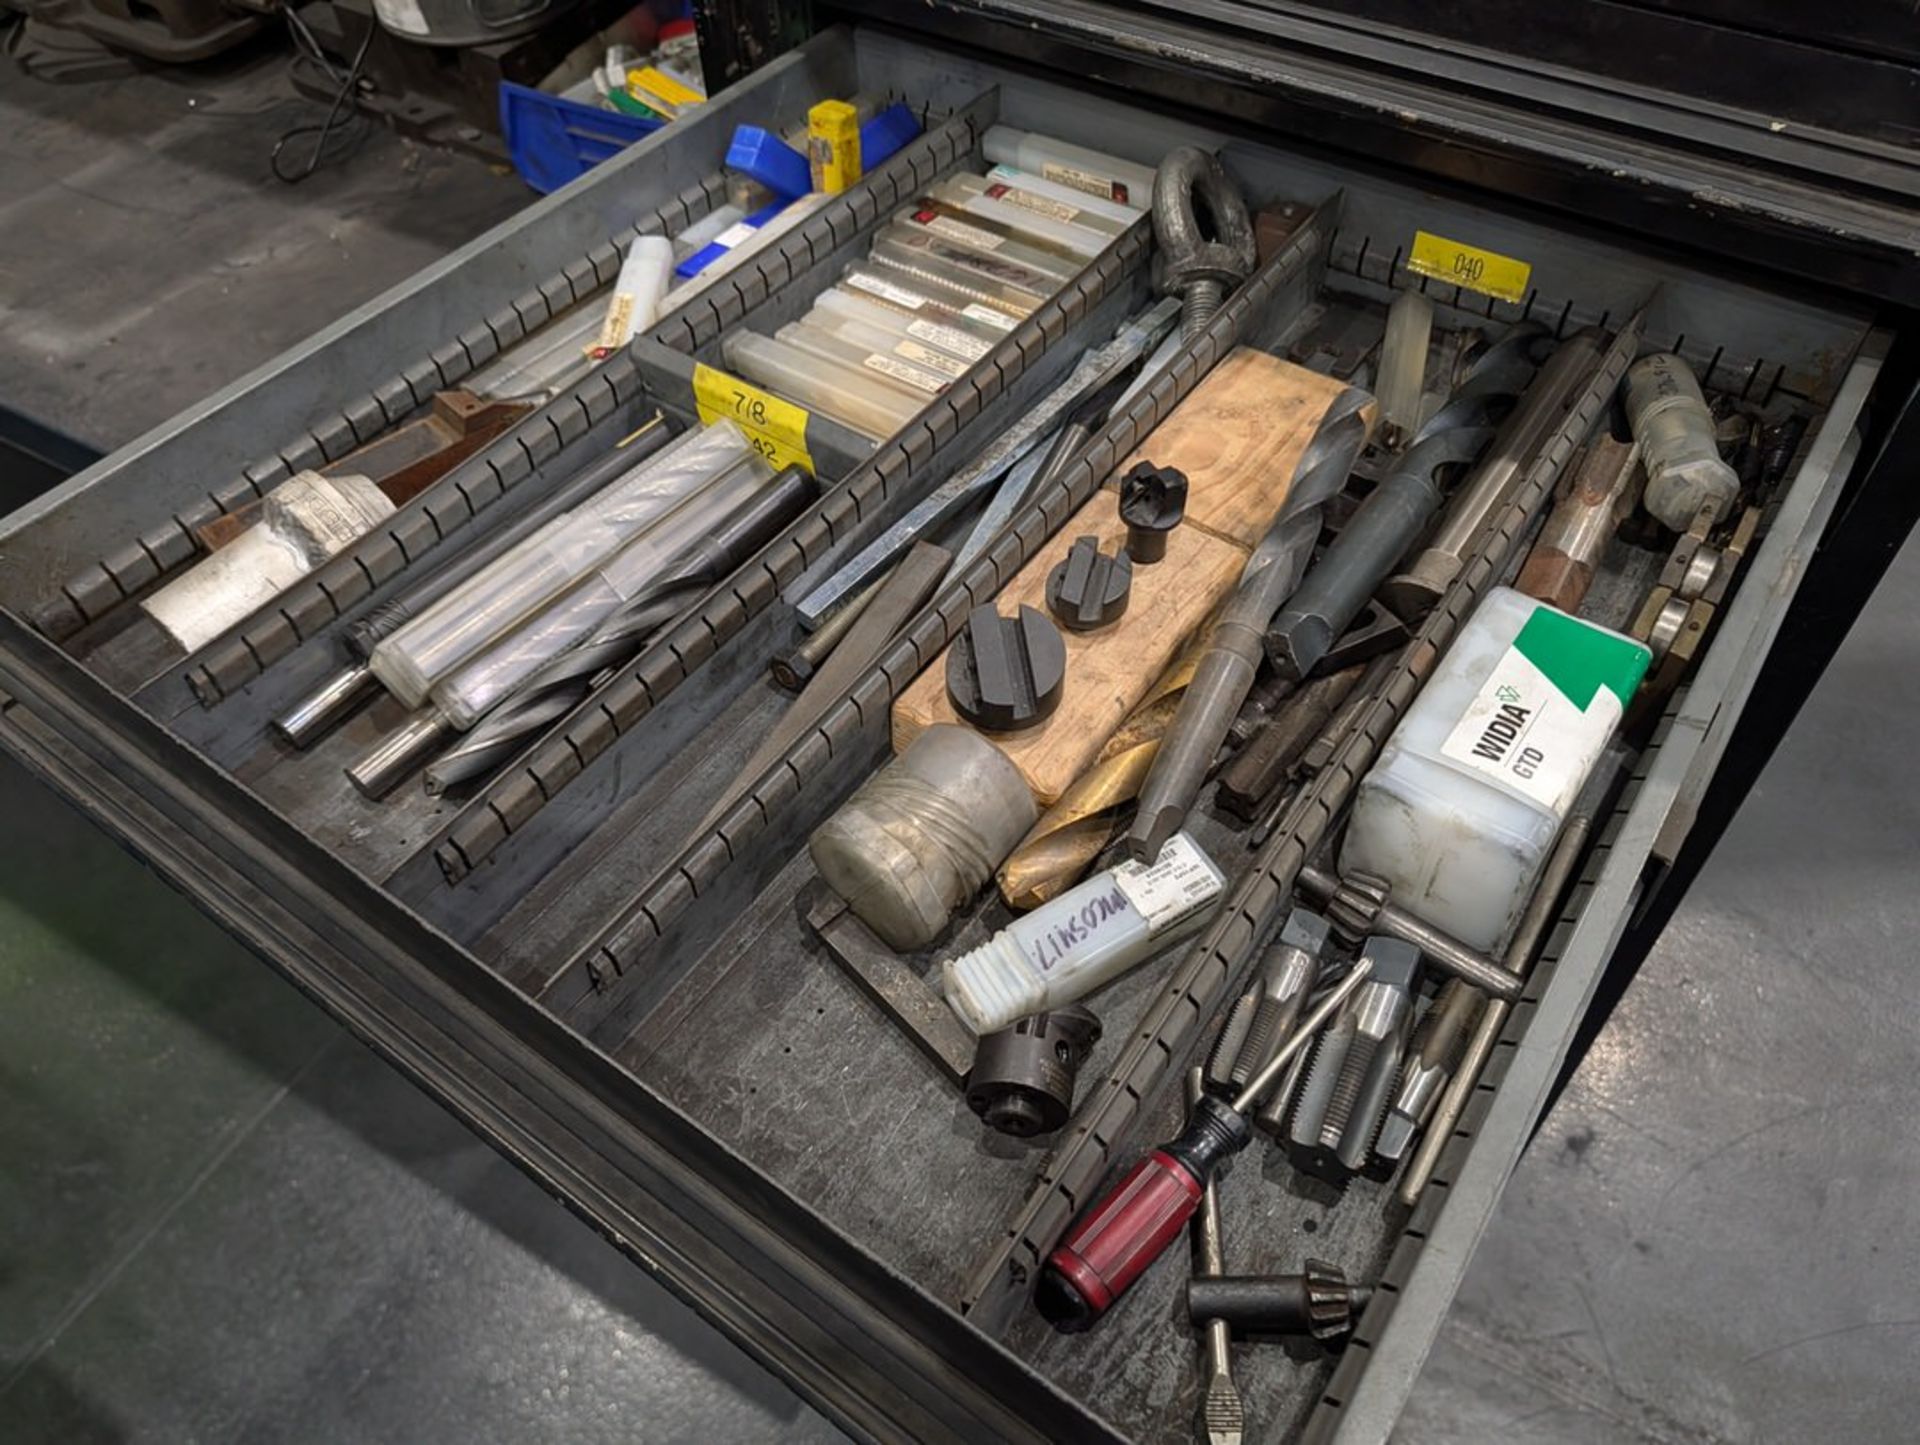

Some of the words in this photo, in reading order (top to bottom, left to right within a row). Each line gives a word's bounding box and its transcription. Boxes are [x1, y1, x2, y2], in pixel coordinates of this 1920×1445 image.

[1454, 252, 1484, 281] 040
[1471, 703, 1532, 762] WIDIA
[1512, 747, 1544, 780] GTD
